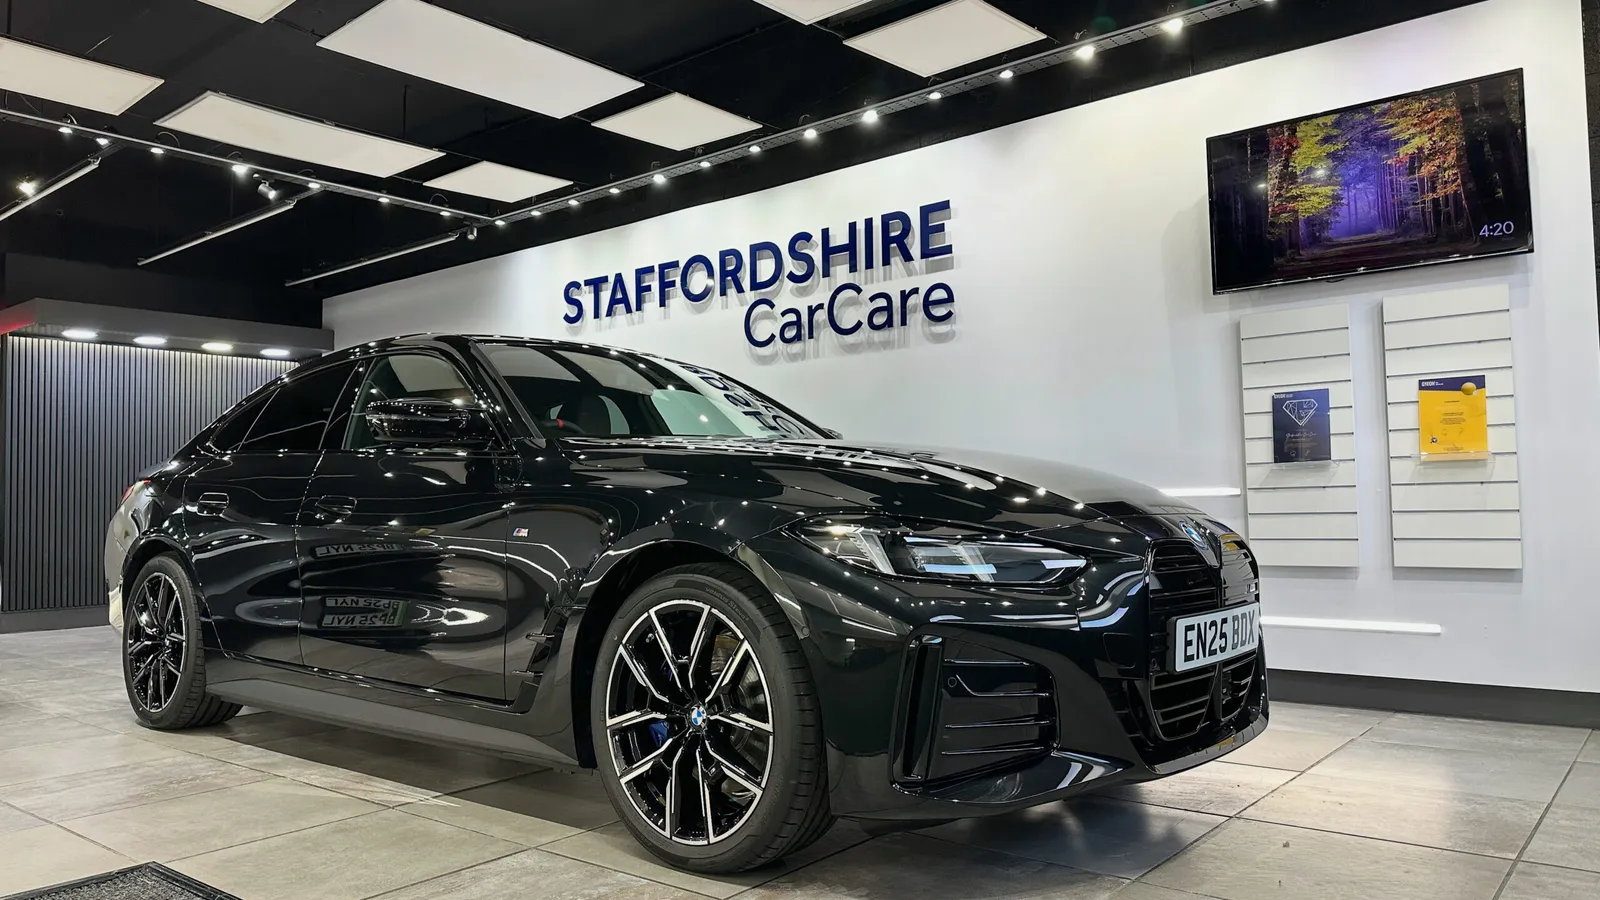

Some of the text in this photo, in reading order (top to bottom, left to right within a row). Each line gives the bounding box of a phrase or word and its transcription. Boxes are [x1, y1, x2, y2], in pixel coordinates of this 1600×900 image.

[1479, 221, 1514, 237] 4:20
[562, 199, 953, 325] STAFFORDSHIRE
[743, 282, 955, 348] CarCare
[327, 598, 360, 607] NYL
[1184, 609, 1255, 663] EN25 BDX
